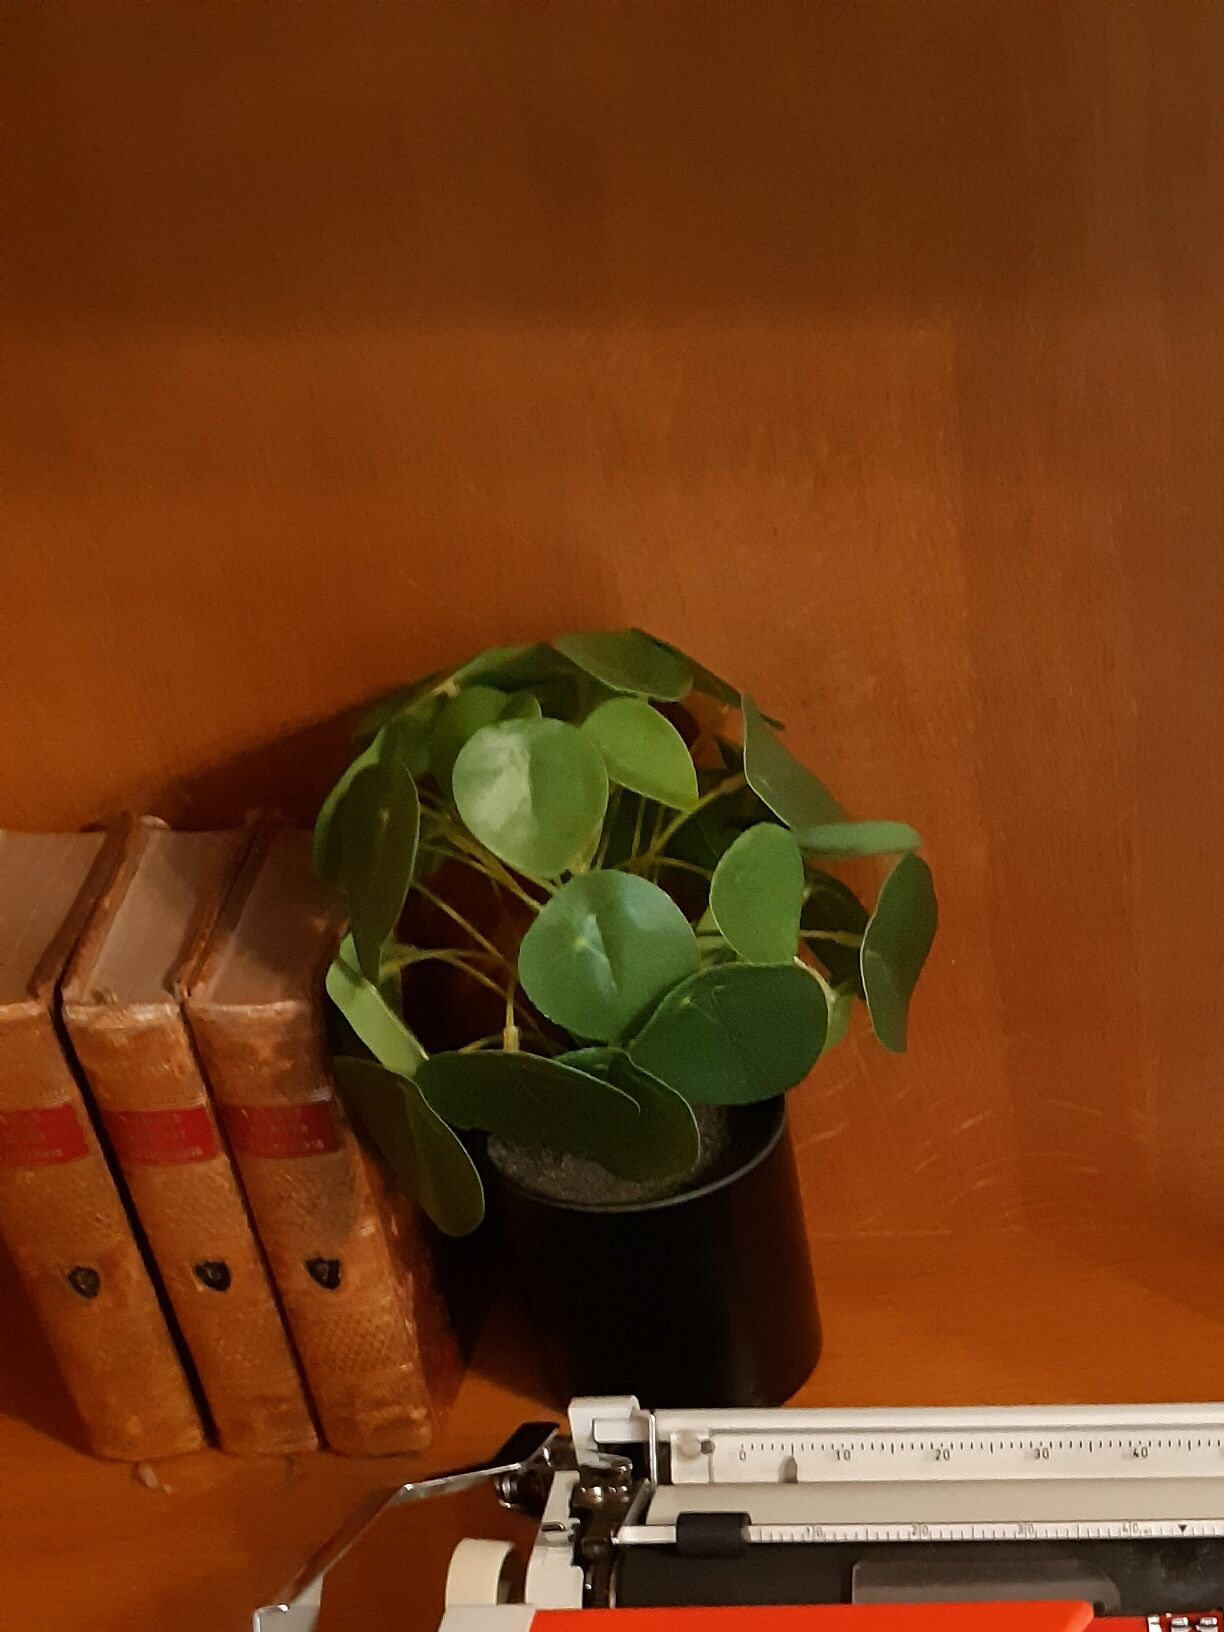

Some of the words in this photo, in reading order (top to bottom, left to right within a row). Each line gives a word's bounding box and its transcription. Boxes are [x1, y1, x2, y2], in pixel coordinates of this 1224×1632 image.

[739, 1450, 746, 1461] 0
[836, 1449, 851, 1461] 10
[1034, 1447, 1050, 1460] 30
[1132, 1447, 1149, 1459] 40
